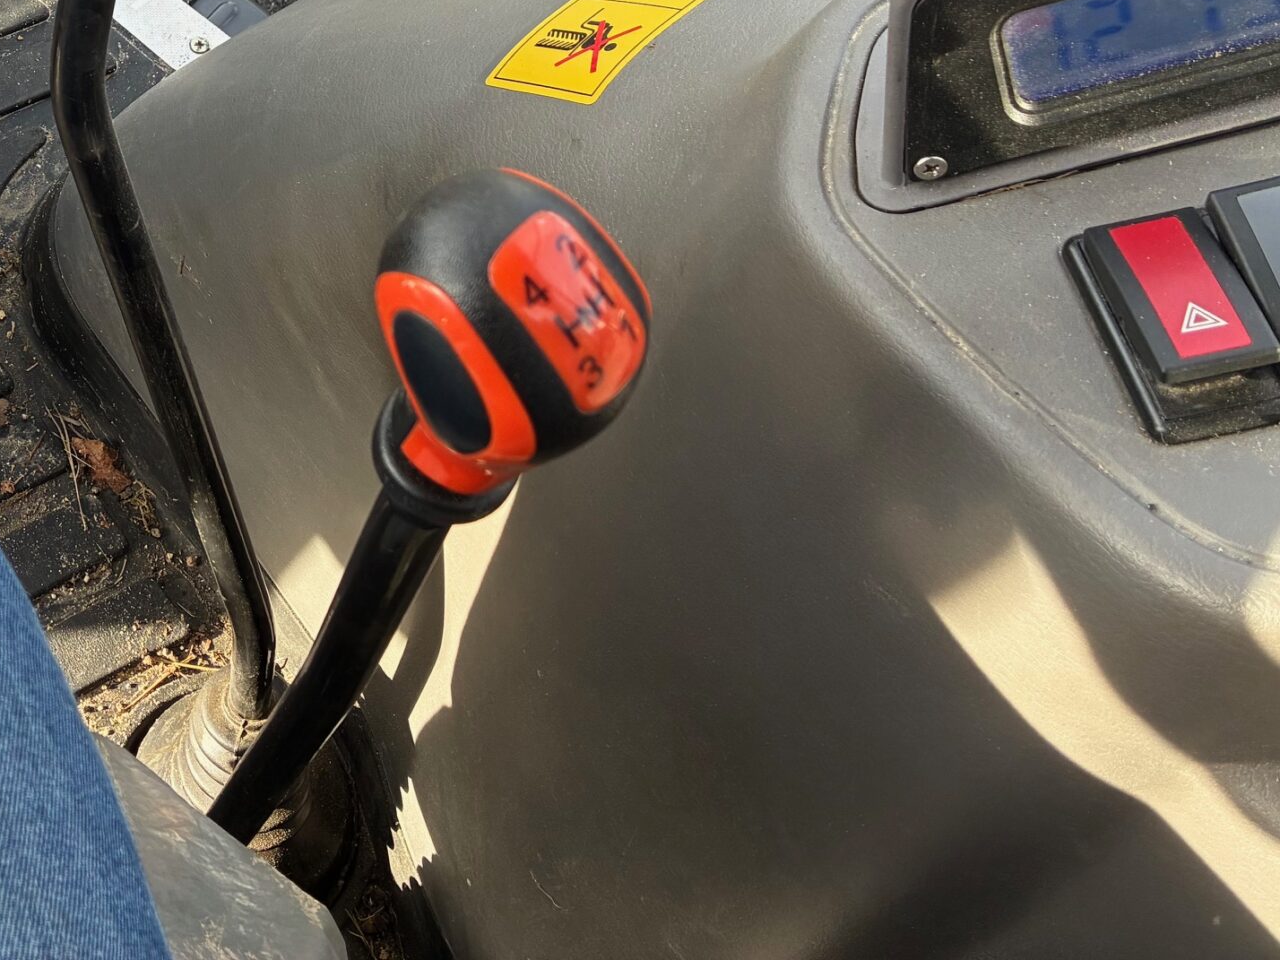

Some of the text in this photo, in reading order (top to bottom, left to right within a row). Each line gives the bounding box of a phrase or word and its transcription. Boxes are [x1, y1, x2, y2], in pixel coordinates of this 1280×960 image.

[522, 234, 588, 307] 4 2
[577, 318, 639, 389] 3 1
